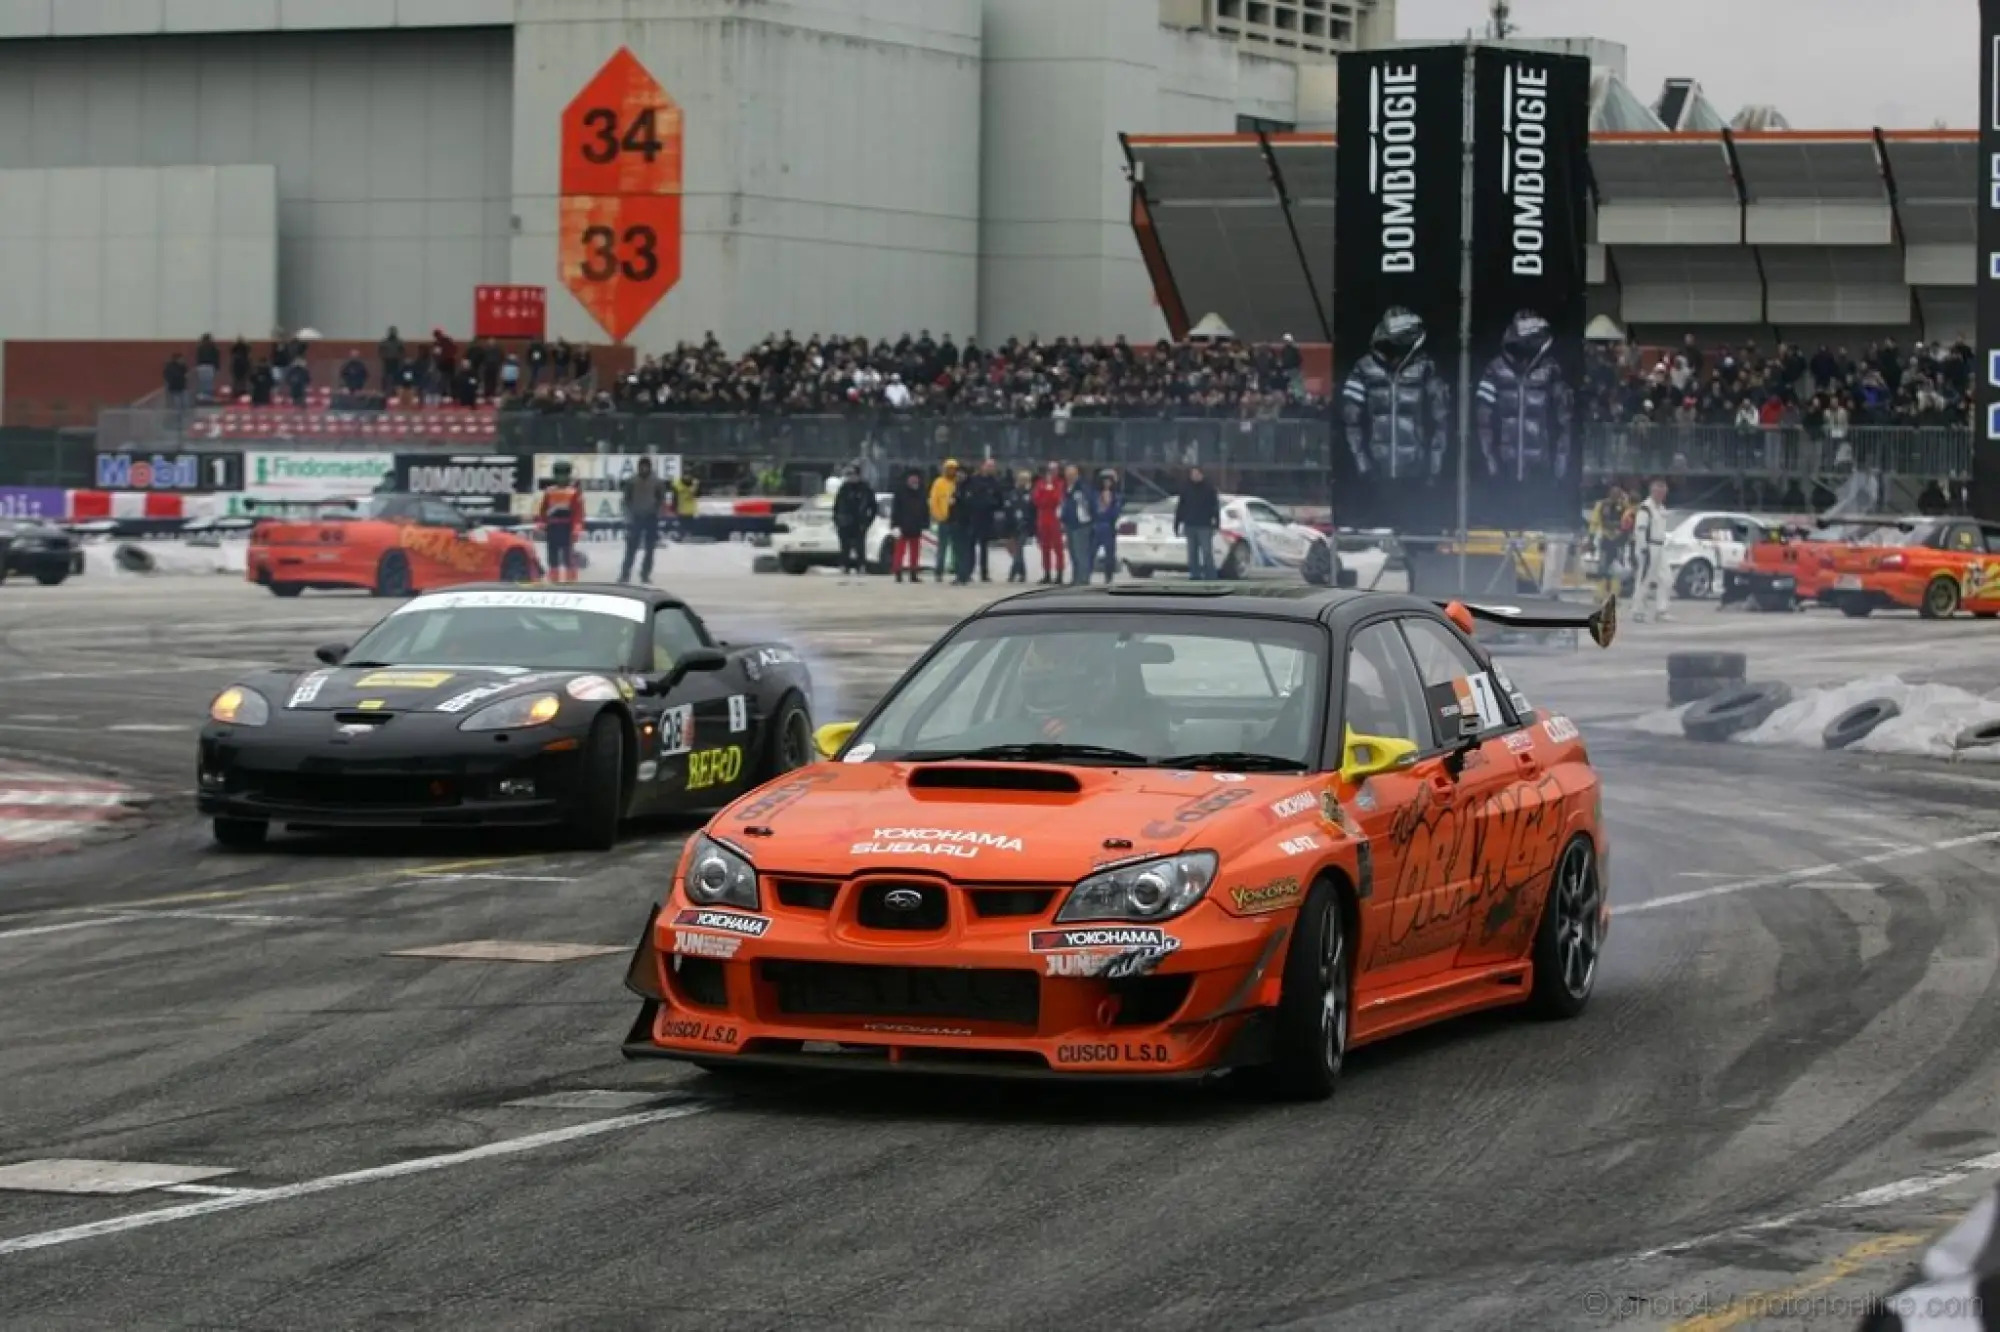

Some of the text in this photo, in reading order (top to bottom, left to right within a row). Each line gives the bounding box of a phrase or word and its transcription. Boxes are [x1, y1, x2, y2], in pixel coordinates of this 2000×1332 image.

[581, 108, 662, 164] 34
[1381, 62, 1417, 273] BOMBOOGIE
[1511, 62, 1547, 276] BOMBOOGIE
[581, 226, 659, 282] 33
[96, 454, 226, 488] Mobil 1
[272, 456, 388, 478] Findomestic
[409, 466, 518, 494] BOMBOOGIE
[850, 841, 979, 859] SUBARU
[872, 827, 1022, 852] YOKOHAMA
[697, 913, 763, 934] YOKOHAMA
[1066, 931, 1159, 945] YOKOHAMA
[662, 1021, 701, 1038] CUSCO
[863, 1023, 973, 1036] YOKOHAMA
[1058, 1044, 1119, 1062] CUSCO
